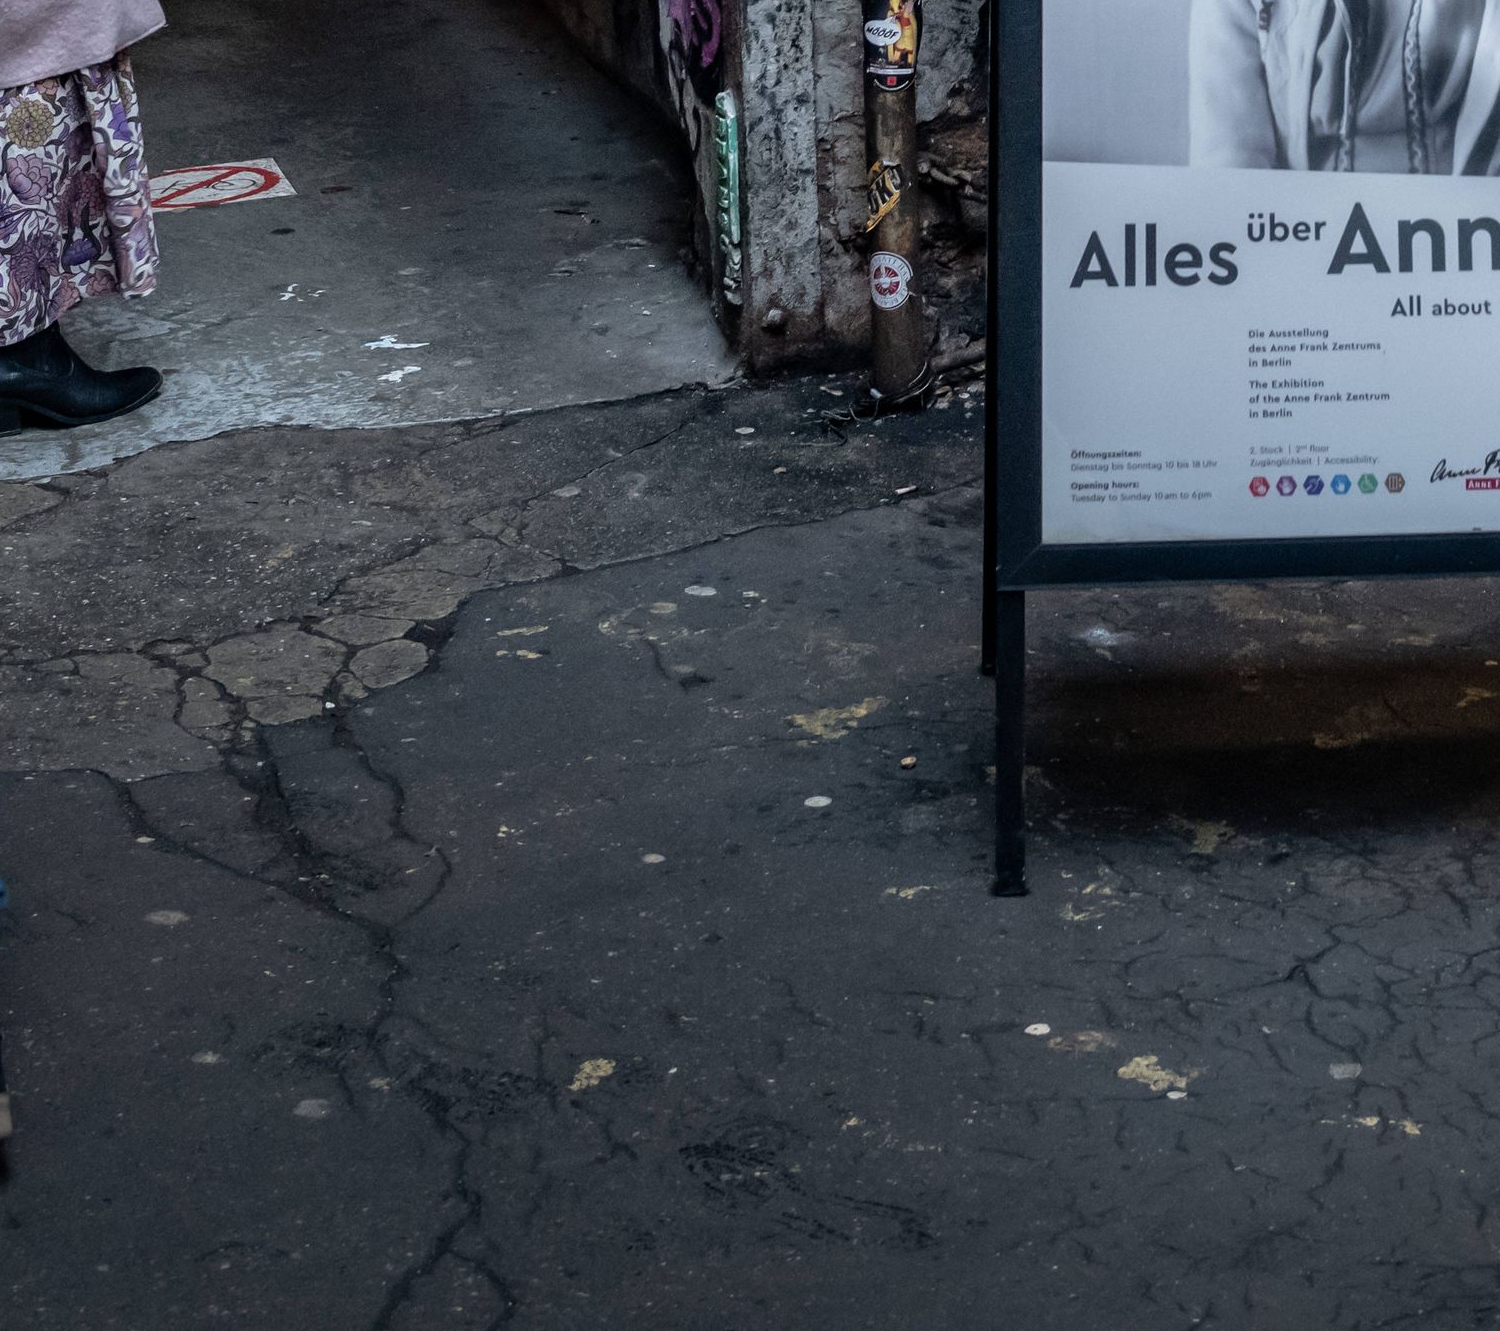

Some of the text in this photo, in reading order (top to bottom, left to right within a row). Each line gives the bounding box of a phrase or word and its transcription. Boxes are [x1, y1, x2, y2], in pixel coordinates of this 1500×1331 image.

[1069, 223, 1239, 289] Alles
[1247, 213, 1326, 243] über
[1391, 296, 1423, 318] All
[1432, 295, 1492, 316] about
[1248, 328, 1329, 338] Die Ausstellung
[1248, 342, 1381, 353] des Anne Frank Zentrums
[1249, 357, 1292, 367] in Berlin
[1249, 378, 1324, 389] The Exhibition
[1249, 392, 1390, 404] of the Anne Frank Zentrum
[1250, 409, 1292, 418] in Berlin
